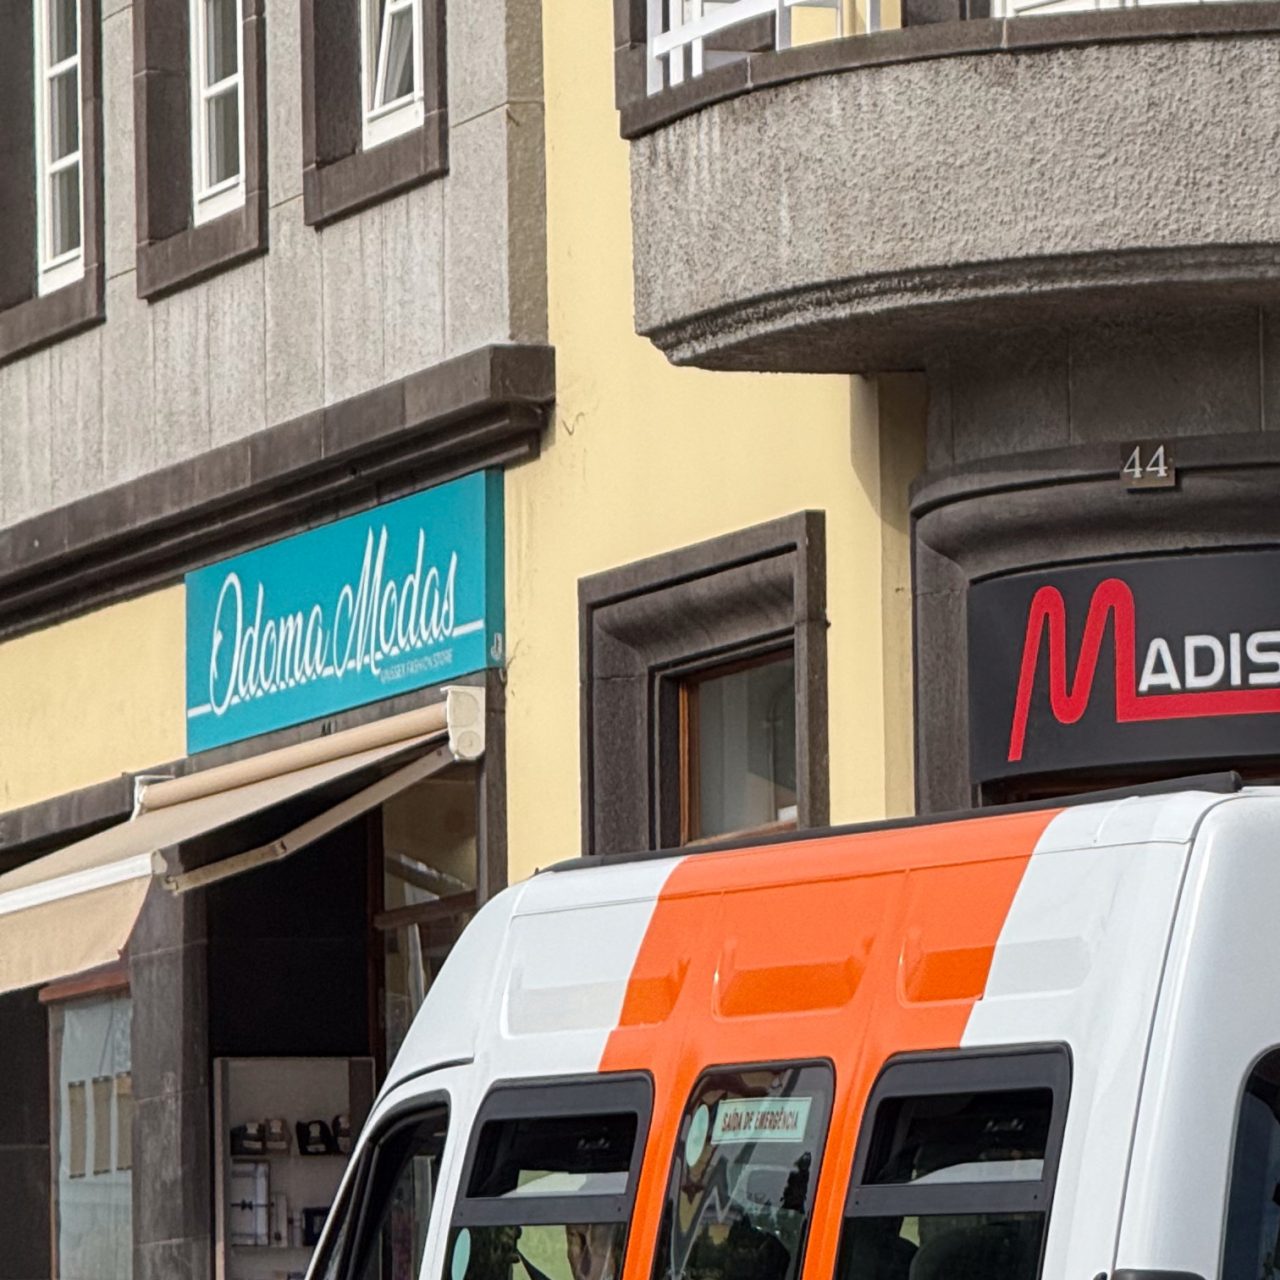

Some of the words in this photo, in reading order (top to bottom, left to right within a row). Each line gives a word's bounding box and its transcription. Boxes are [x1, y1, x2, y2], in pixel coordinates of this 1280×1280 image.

[1122, 444, 1168, 479] 44
[333, 523, 459, 679] Modas
[743, 1111, 754, 1130] DE
[755, 1105, 799, 1131] EMERGÊNCIA
